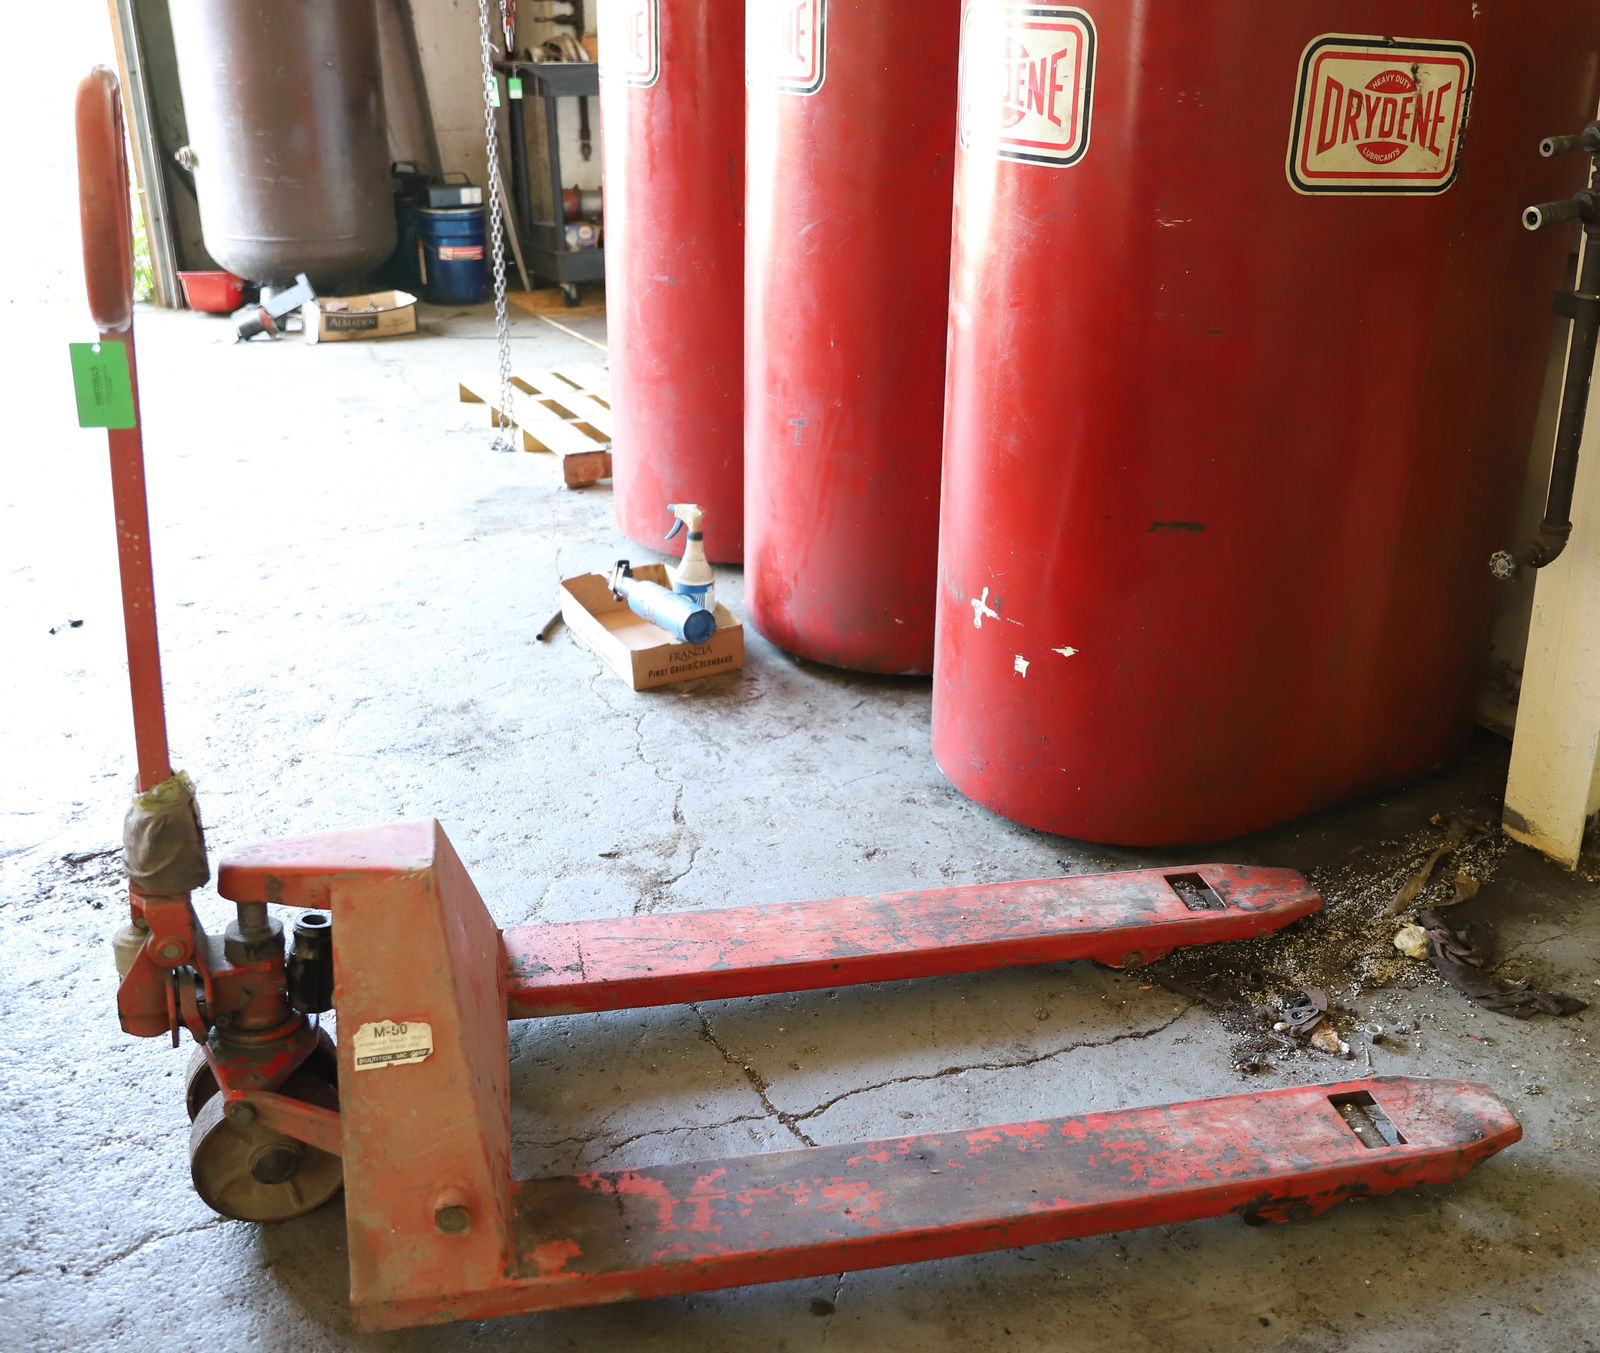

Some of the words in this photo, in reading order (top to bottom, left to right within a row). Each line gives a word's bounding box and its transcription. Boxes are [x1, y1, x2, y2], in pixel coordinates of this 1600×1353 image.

[1372, 74, 1395, 89] HEAVY
[1395, 75, 1412, 89] DUTY
[1316, 75, 1452, 157] DRYDENE
[1362, 147, 1401, 162] LUBRICANTS
[669, 646, 712, 662] FRANZIA
[649, 668, 668, 678] PINOT
